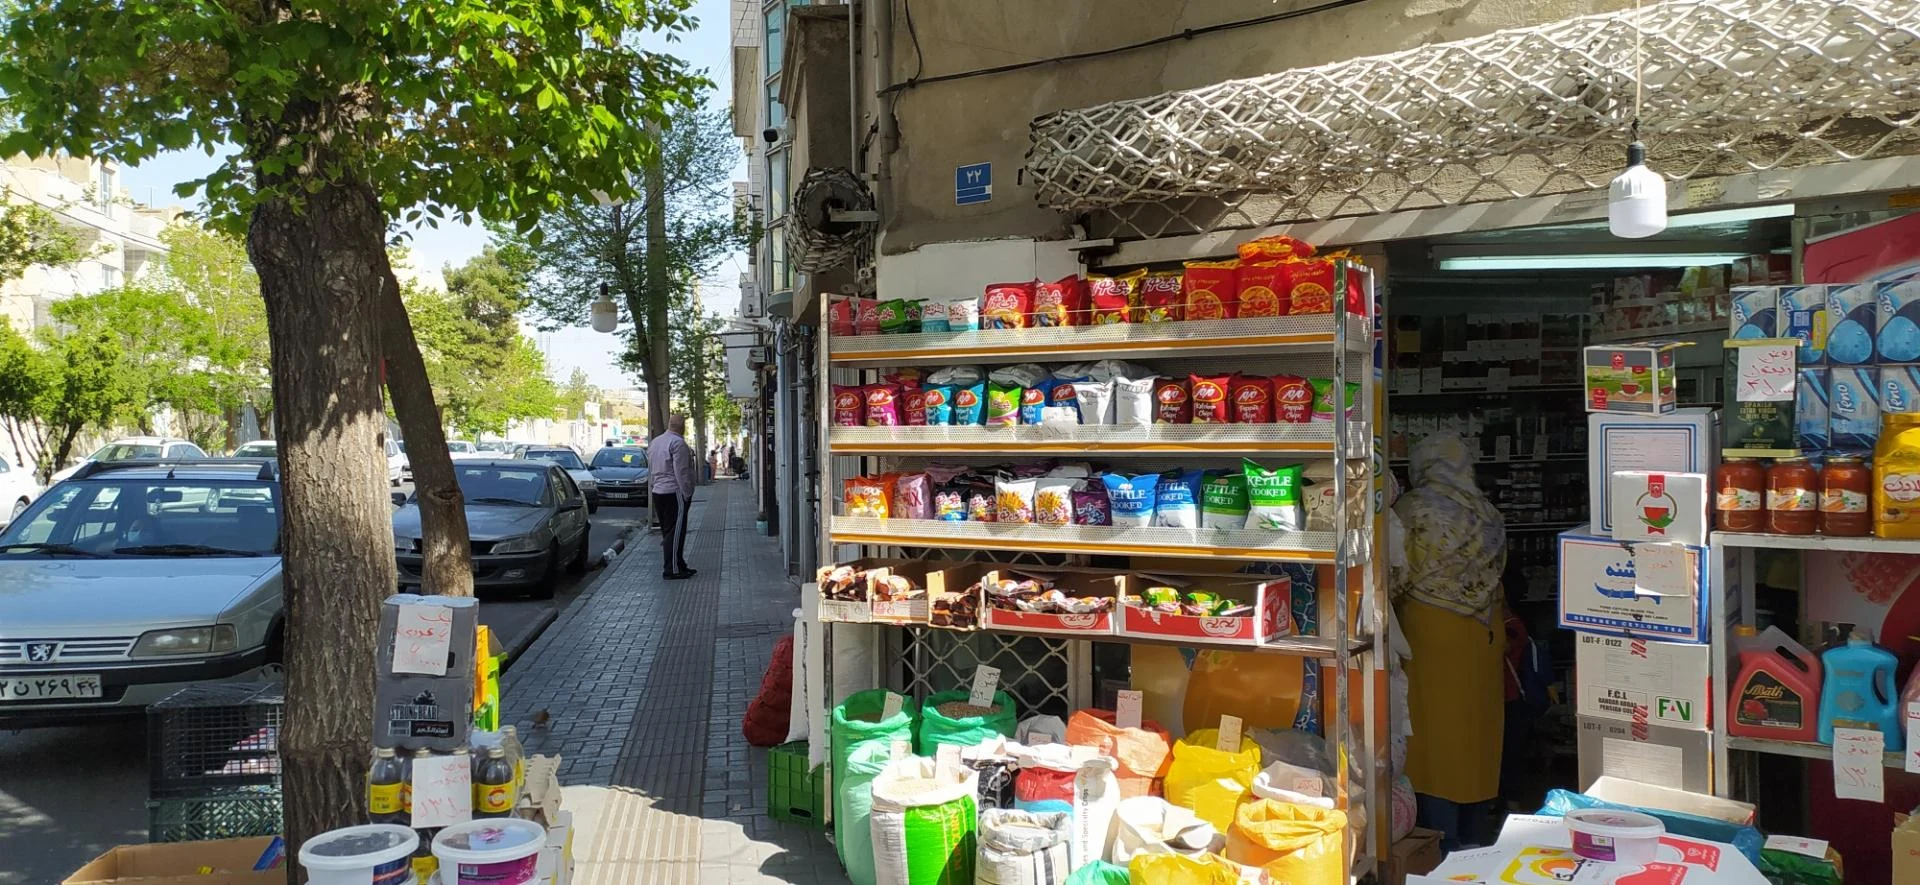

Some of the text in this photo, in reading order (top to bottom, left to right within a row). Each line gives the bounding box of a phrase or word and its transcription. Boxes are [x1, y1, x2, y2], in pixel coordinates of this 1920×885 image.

[966, 169, 982, 184] ۲۲
[1839, 384, 1856, 414] Teno
[1157, 481, 1190, 491] ETTLE
[1247, 475, 1293, 487] KETTLE
[1251, 489, 1287, 497] COOKED
[1606, 560, 1636, 577] شنه
[1621, 621, 1658, 630] CEYLON
[1605, 639, 1622, 647] 0122
[35, 679, 72, 696] ۲۶۹
